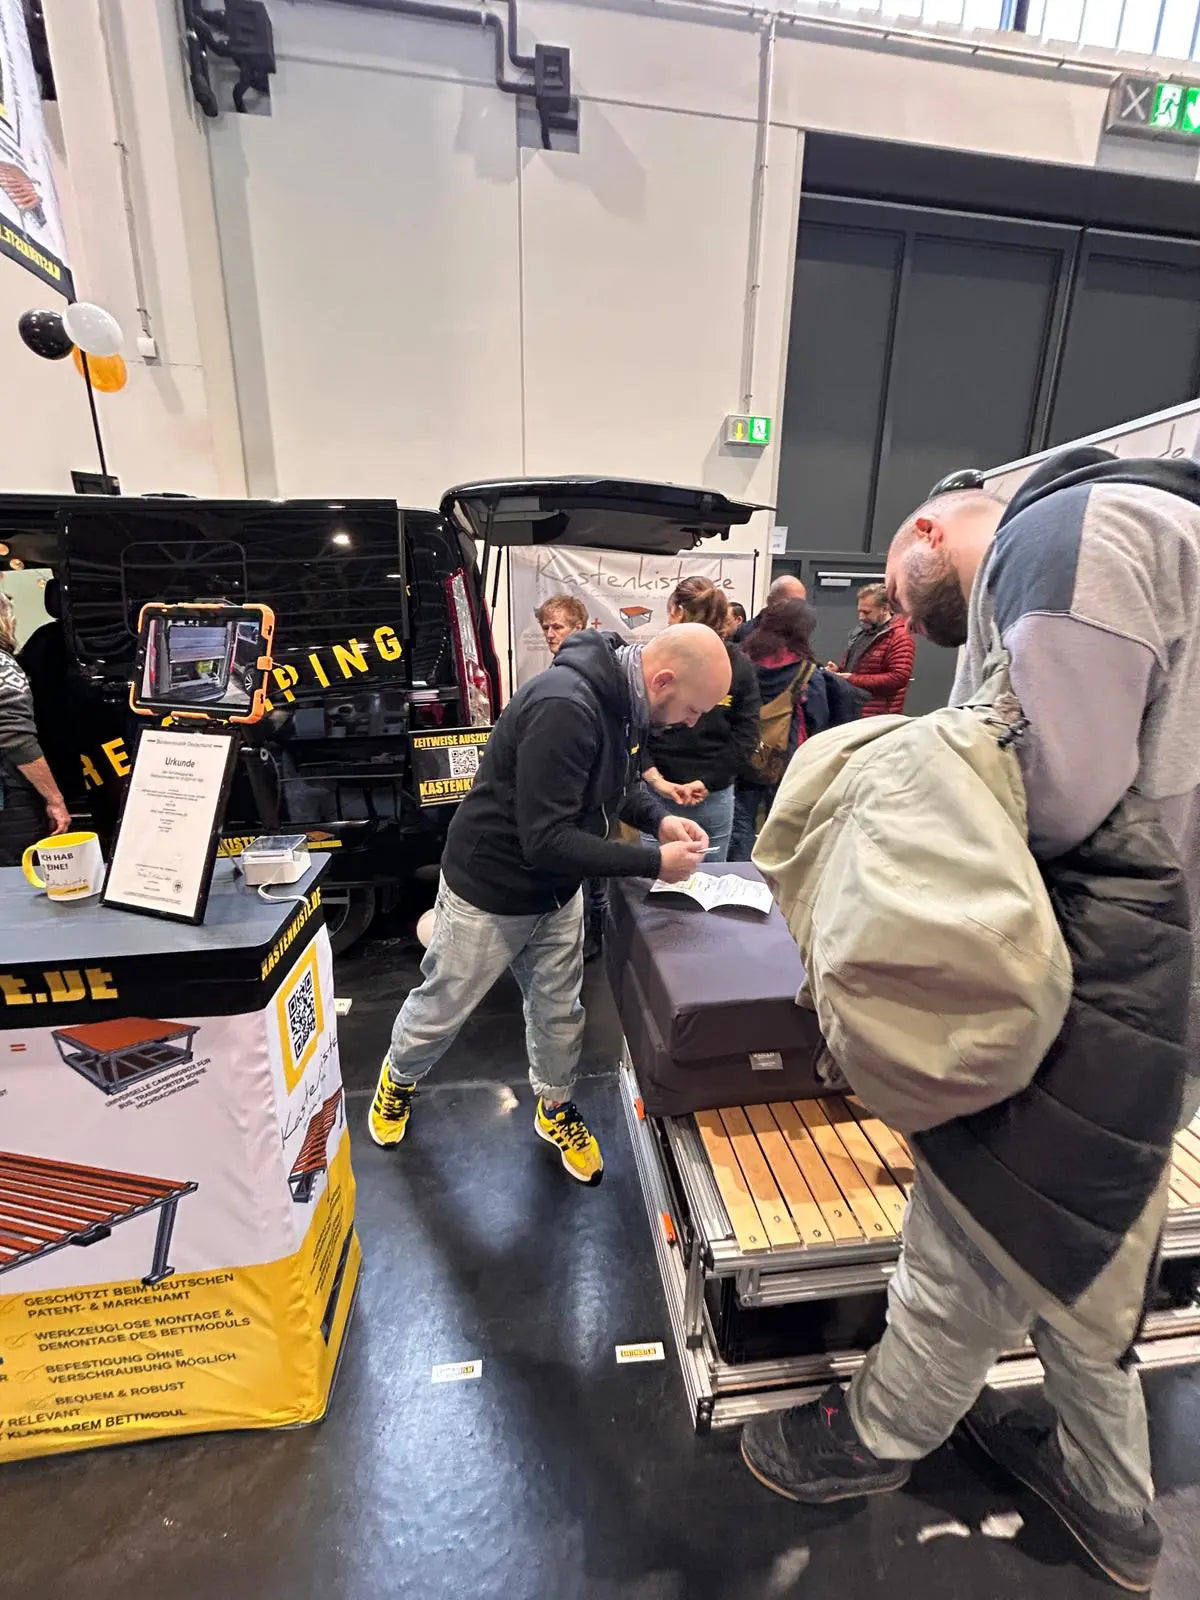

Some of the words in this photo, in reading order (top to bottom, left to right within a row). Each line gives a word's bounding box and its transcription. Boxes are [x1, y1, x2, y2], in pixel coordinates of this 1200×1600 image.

[264, 626, 402, 712] PING
[413, 735, 459, 748] ZEITWEISE
[165, 757, 195, 769] Urkunde
[54, 852, 74, 861] HAB
[105, 1083, 151, 1107] UNIVERSELLE
[152, 1064, 196, 1087] CAMPINGBOX
[136, 1078, 187, 1101] TRANSPORTER
[185, 1067, 207, 1080] SOWIE
[24, 1289, 109, 1307] GESCHÜTZT
[113, 1285, 148, 1297] BEIM
[151, 1273, 234, 1293] DEUTSCHEN
[28, 1304, 86, 1318] PATENT-
[89, 1302, 99, 1311] &
[103, 1290, 190, 1309] MARKENAMT
[35, 1320, 151, 1340] WERKZEUGLOSE
[154, 1310, 220, 1326] MONTAGE
[225, 1308, 234, 1316] &
[38, 1333, 125, 1351] DEMONTAGE
[129, 1329, 157, 1341] DES
[161, 1317, 250, 1336] BETTMODULS
[45, 1354, 143, 1373] BEFESTIGUNG
[146, 1348, 184, 1361] OHNE
[49, 1362, 172, 1384] VERSCHRAUBUNG
[176, 1353, 237, 1368] MÖGLICH
[55, 1390, 113, 1405] BEQUEM
[118, 1389, 127, 1397] &
[131, 1381, 185, 1397] ROBUST
[8, 1408, 81, 1428] RELEVANT
[105, 1408, 188, 1427] BETTMODUL
